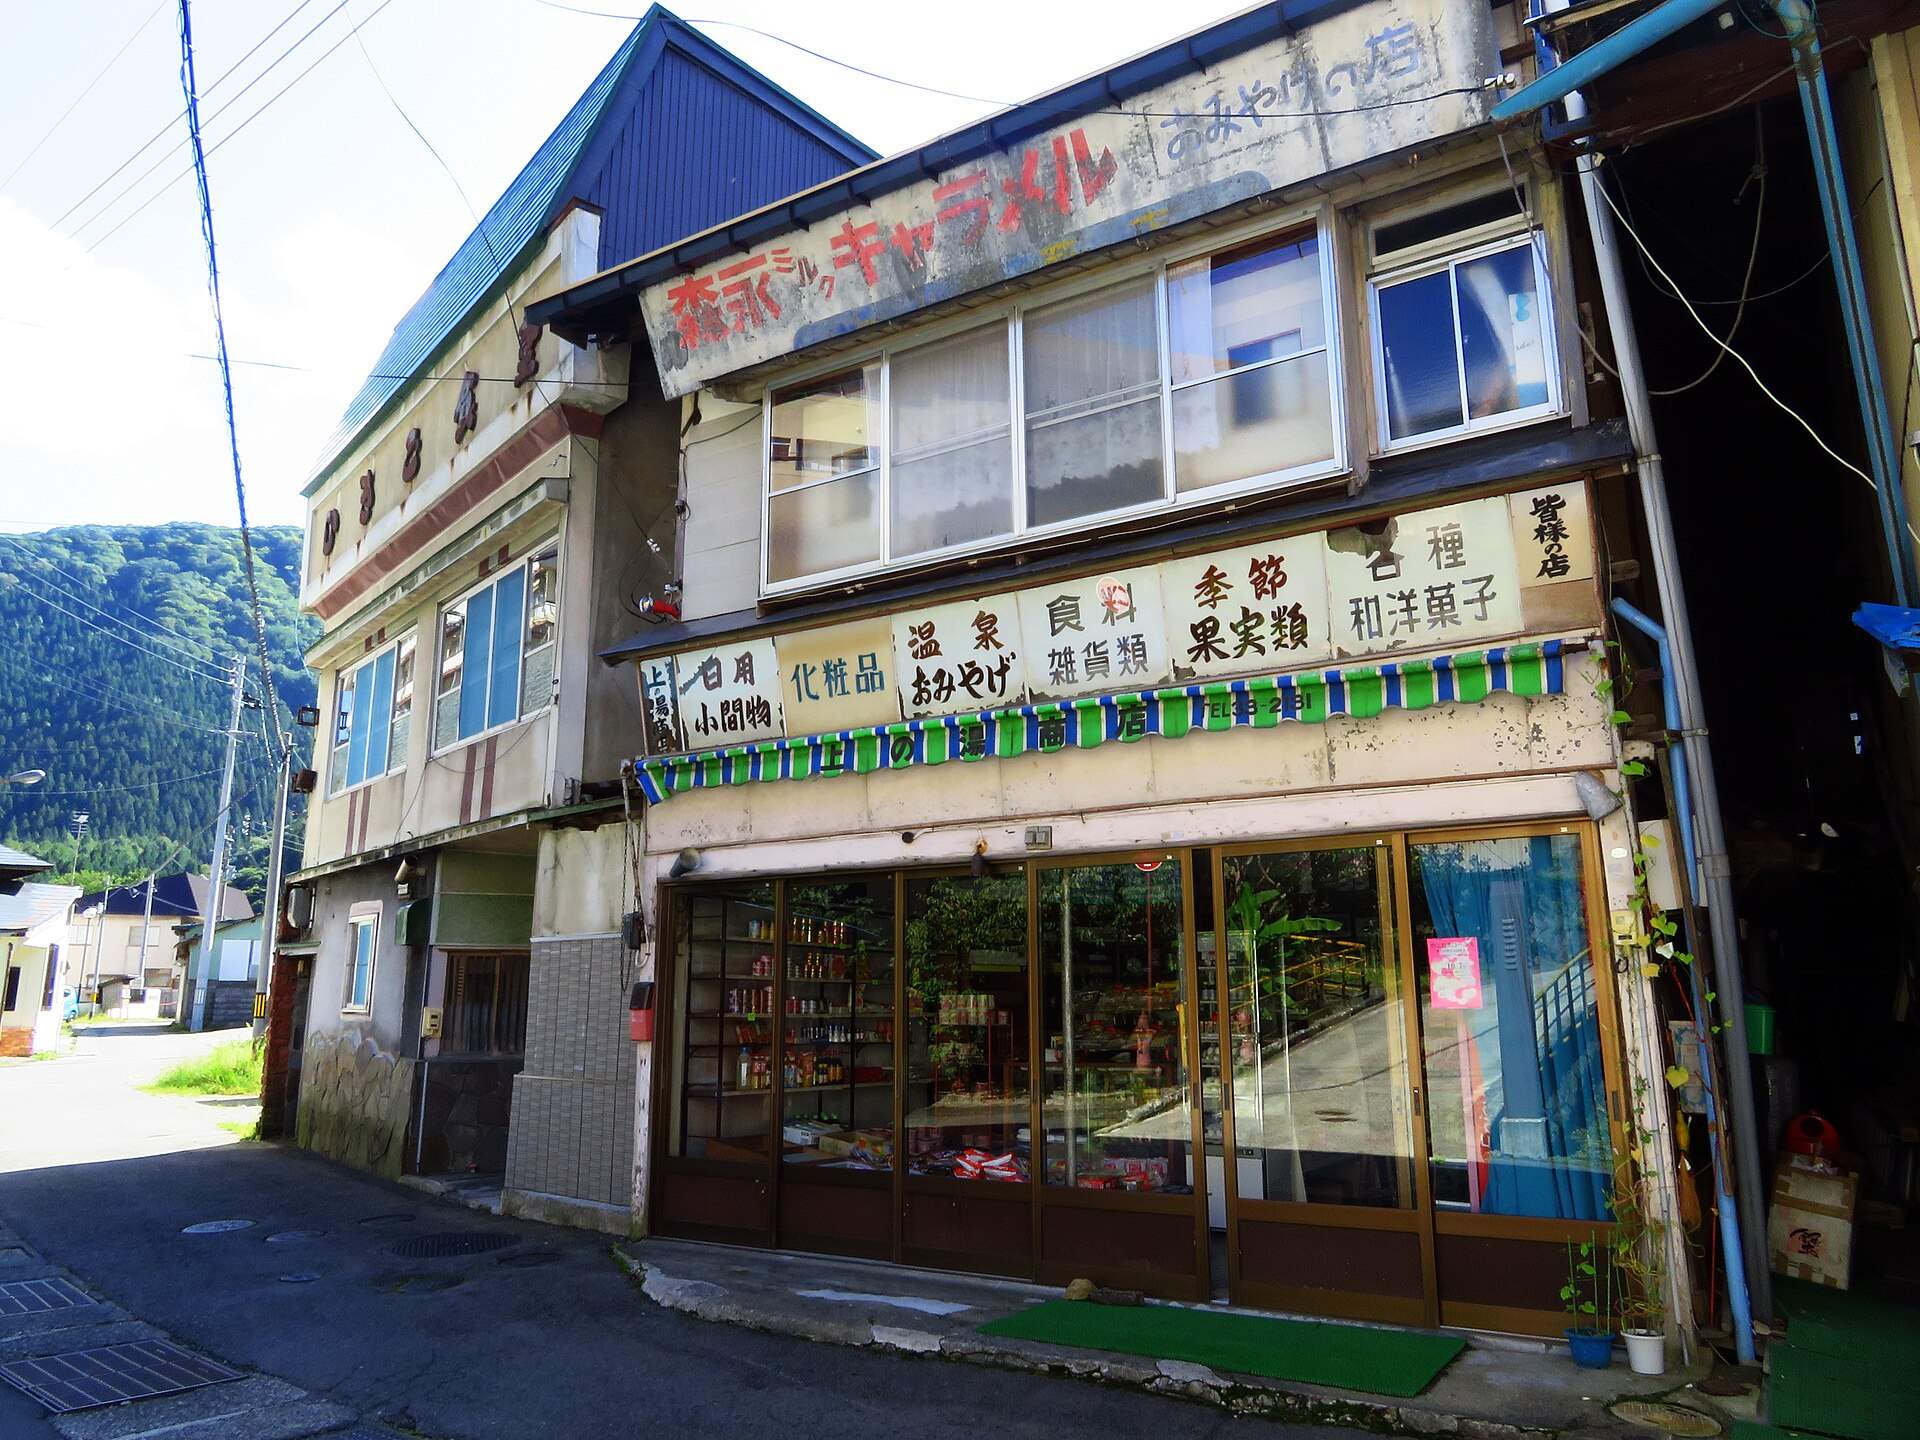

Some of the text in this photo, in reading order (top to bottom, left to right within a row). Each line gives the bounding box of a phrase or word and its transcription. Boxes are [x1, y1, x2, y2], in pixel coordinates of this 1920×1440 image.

[1529, 493, 1571, 579] 皆様の店
[1194, 554, 1288, 610] 季節
[1349, 574, 1497, 641] 和洋菓子
[907, 610, 1005, 660] 温泉
[1046, 583, 1137, 637] 食料
[1187, 602, 1309, 664] 果実類
[701, 651, 756, 692] 日用
[790, 652, 886, 703] 化粧品
[911, 650, 1017, 707] おみやげ
[1047, 632, 1149, 686] 雑貨類
[695, 695, 772, 736] 小間物
